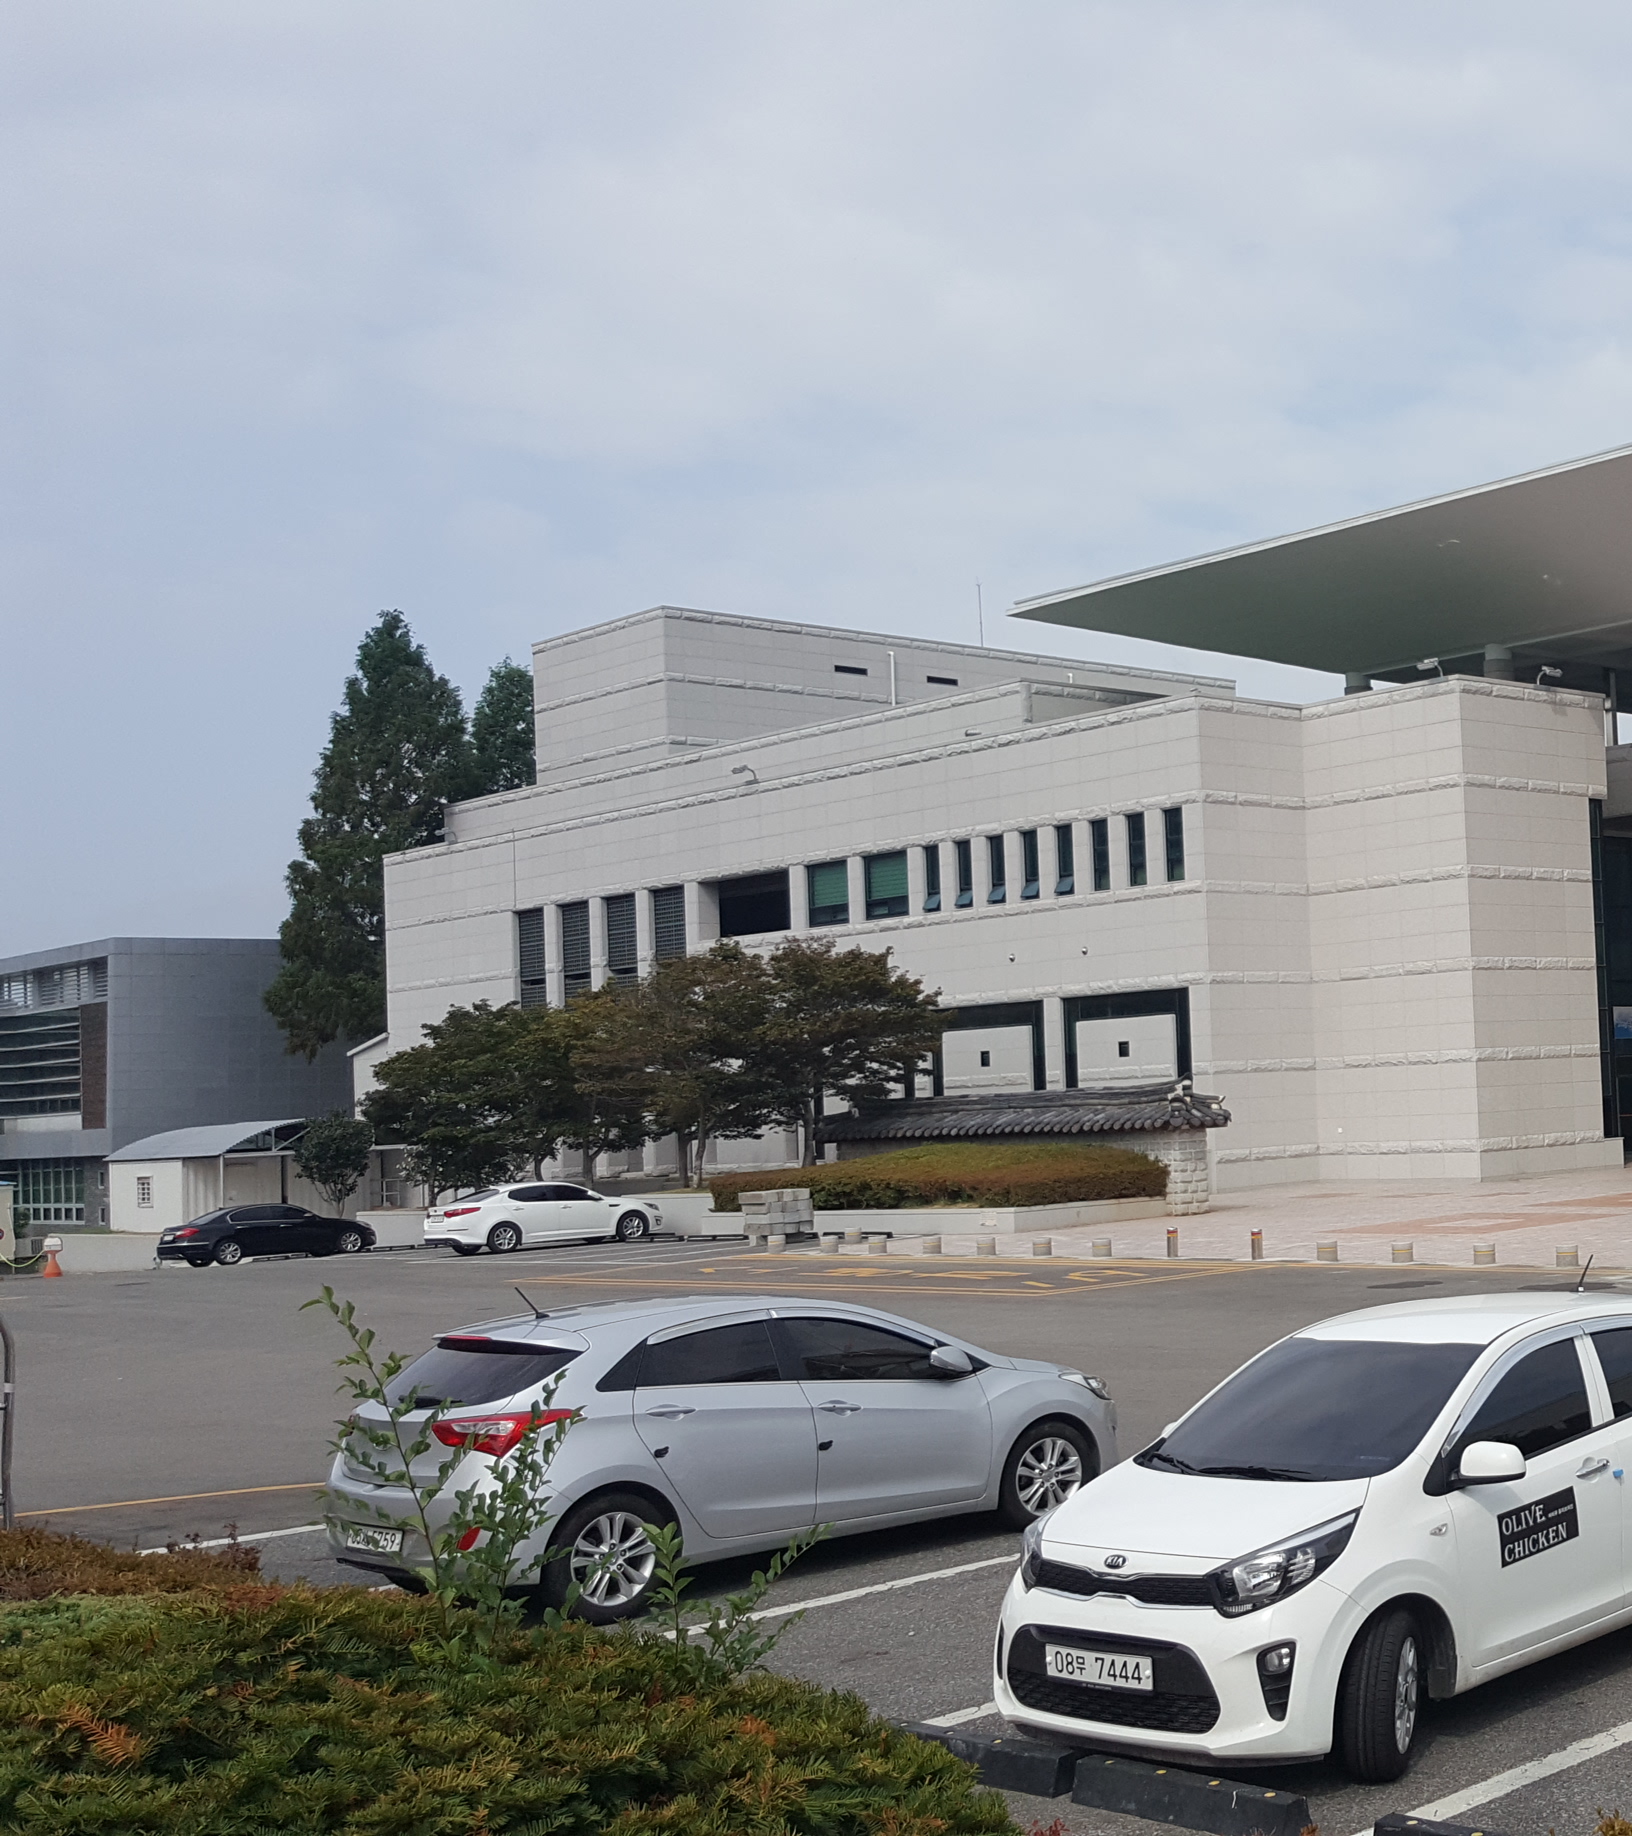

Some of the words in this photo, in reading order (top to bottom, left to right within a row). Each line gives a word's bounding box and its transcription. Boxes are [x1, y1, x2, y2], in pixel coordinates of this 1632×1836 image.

[1502, 1503, 1546, 1536] OLIVE
[1504, 1521, 1568, 1562] CHICKEN
[1106, 1556, 1124, 1567] KIA
[1055, 1650, 1087, 1676] 08무
[1094, 1656, 1143, 1685] 7444
